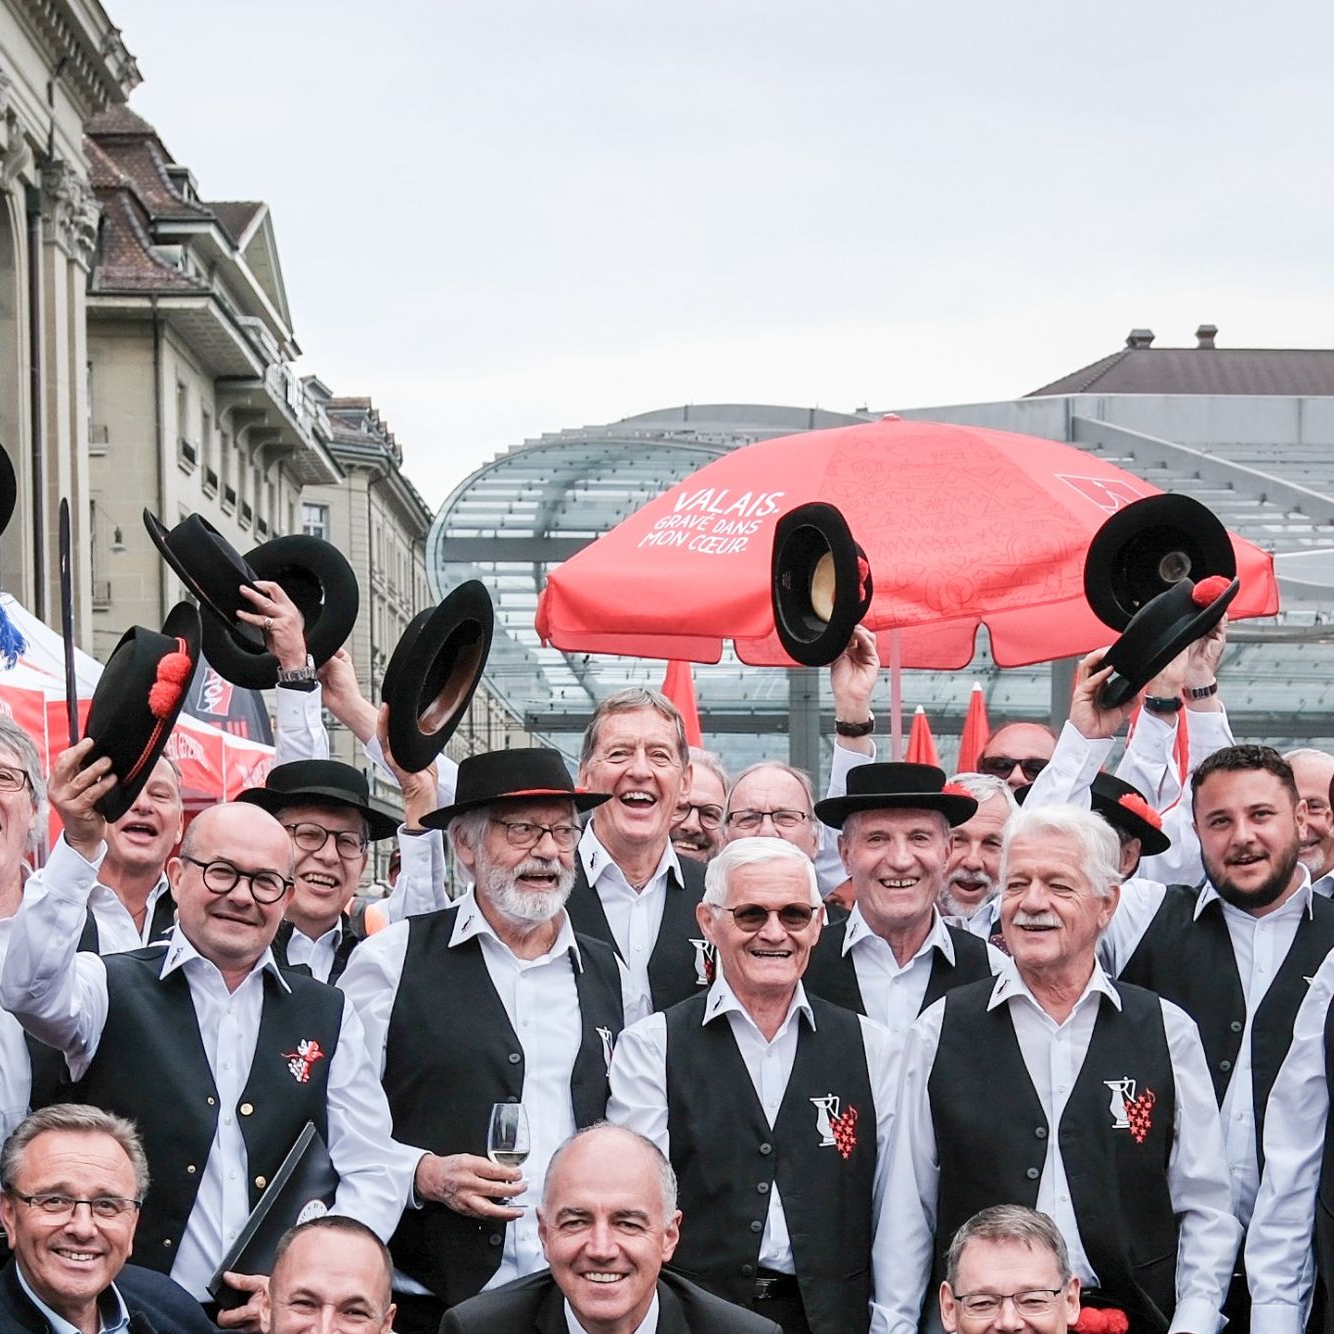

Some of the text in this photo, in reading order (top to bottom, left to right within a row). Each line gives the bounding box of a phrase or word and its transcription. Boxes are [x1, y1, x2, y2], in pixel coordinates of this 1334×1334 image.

[673, 487, 785, 517] VALAIS.
[654, 513, 763, 535] GRAVÉ DANS
[637, 530, 690, 548] MON
